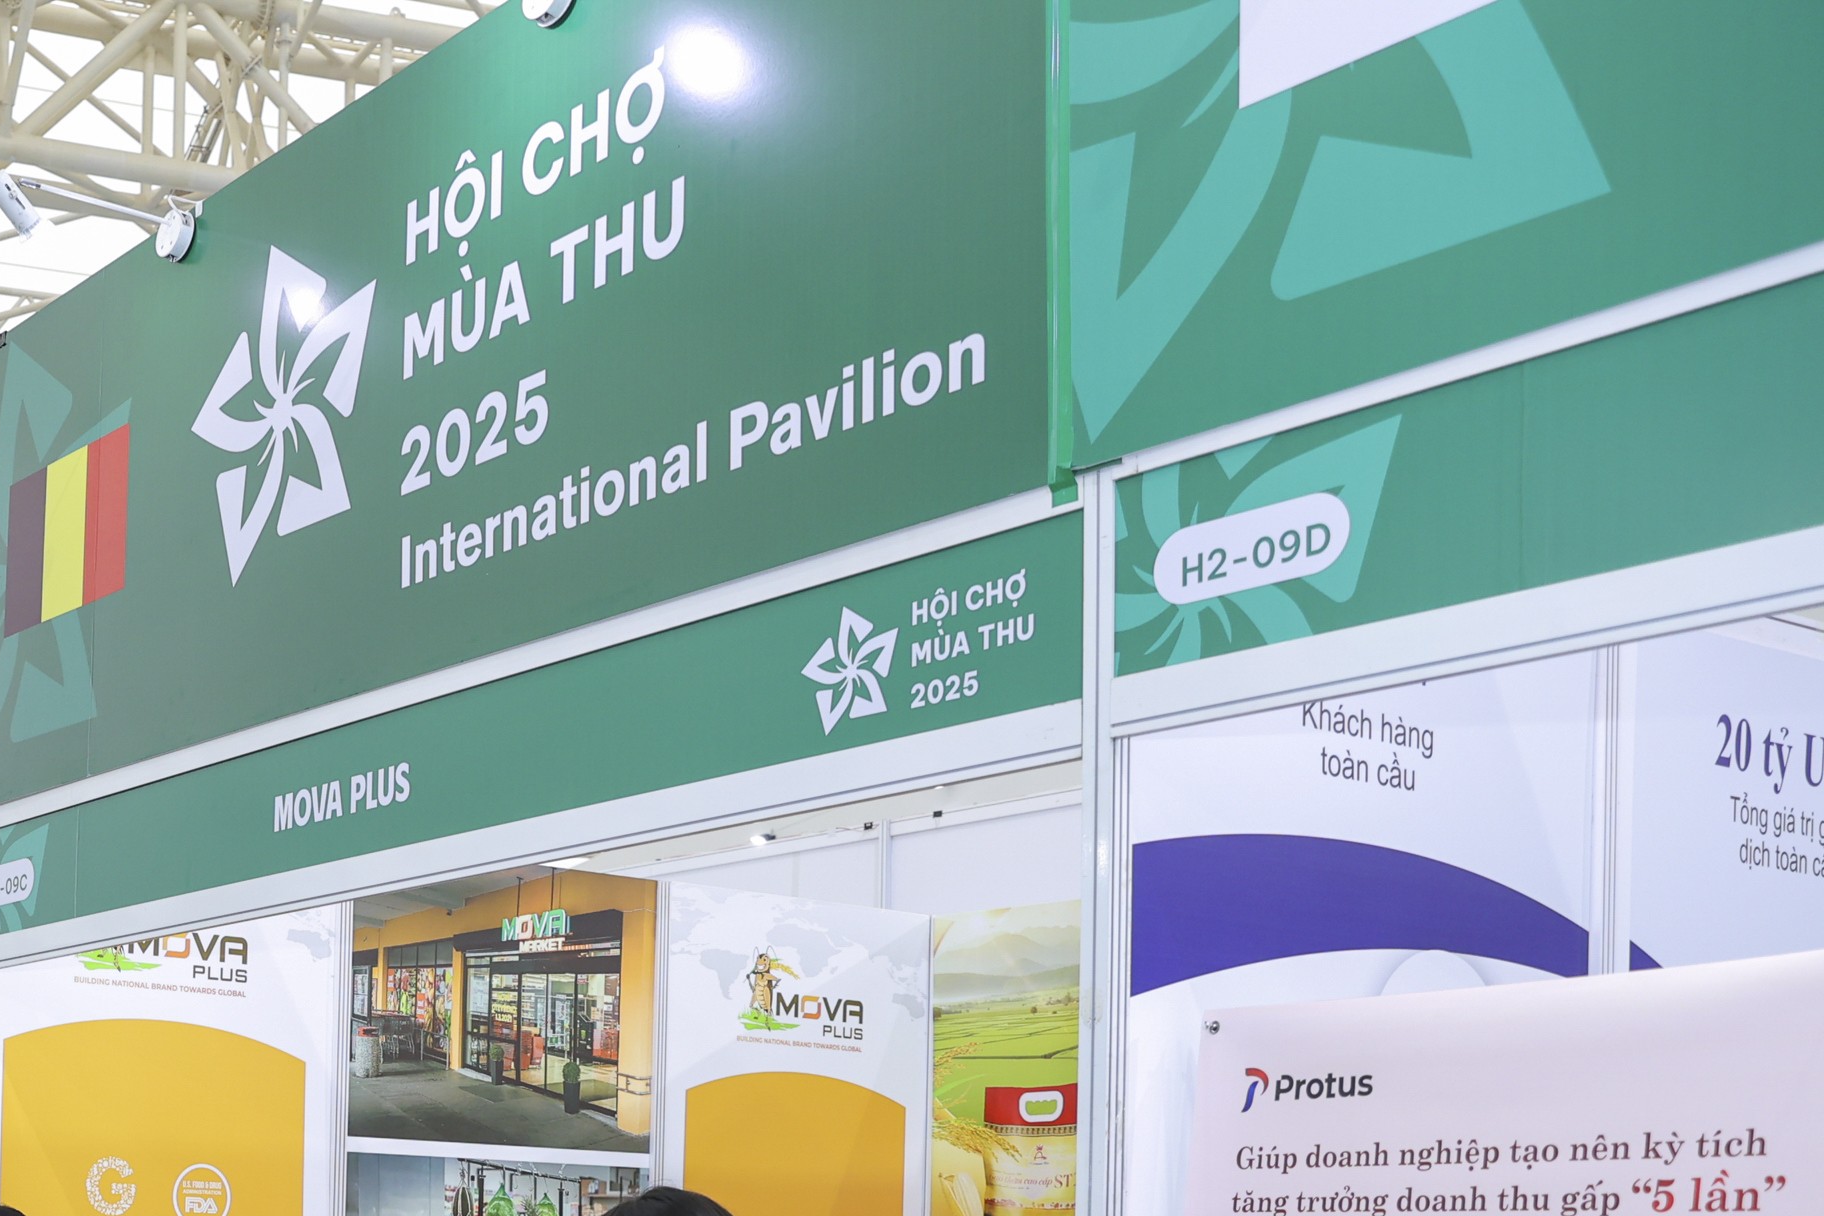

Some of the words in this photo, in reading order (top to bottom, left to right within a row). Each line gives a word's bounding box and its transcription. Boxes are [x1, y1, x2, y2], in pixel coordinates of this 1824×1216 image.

[405, 148, 505, 266] HỘI
[521, 46, 666, 195] CHỢ
[403, 260, 530, 380] MÙA
[550, 176, 685, 305] THU
[400, 370, 548, 496] 2025
[400, 421, 707, 589] International
[729, 333, 987, 470] Pavilion
[1181, 522, 1332, 587] H2-09D
[911, 587, 957, 626] HỘI
[965, 568, 1026, 610] CHỢ
[911, 629, 970, 667] MÙA
[978, 614, 1035, 650] THU
[910, 670, 978, 709] 2025
[1301, 701, 1373, 741] Khách
[1380, 713, 1435, 759] hàng
[1321, 748, 1369, 783] toàn
[1377, 752, 1416, 792] cầu
[1715, 714, 1752, 771] 20
[1763, 727, 1793, 794] tỷ
[274, 780, 343, 832] MOVA
[350, 762, 410, 814] PLUS
[1730, 793, 1768, 835] Tổng
[1774, 807, 1795, 837] giá
[1800, 811, 1814, 842] trị
[1740, 838, 1770, 870] dịch
[1776, 845, 1807, 874] toàn
[501, 908, 568, 942] MOVA
[519, 937, 565, 952] MARKET
[74, 976, 109, 986] BUILDING
[112, 981, 149, 989] NATIONAL
[152, 984, 177, 992] BRAND
[180, 986, 216, 995] TOWARDS
[218, 989, 246, 998] GLOBAL
[193, 965, 248, 983] PLUS
[776, 992, 864, 1024] MOVA
[822, 1025, 863, 1040] PLUS
[1275, 1071, 1373, 1102] Protus
[1236, 1145, 1298, 1173] Giúp
[1305, 1143, 1389, 1169] doanh
[1399, 1140, 1500, 1172] nghiệp
[1510, 1140, 1559, 1171] tạo
[1569, 1133, 1631, 1162] nên
[1642, 1132, 1685, 1166] kỳ
[1696, 1128, 1767, 1159] tích
[185, 1197, 218, 1214] FDA
[1396, 1187, 1487, 1213] doanh
[1497, 1186, 1550, 1212] thu
